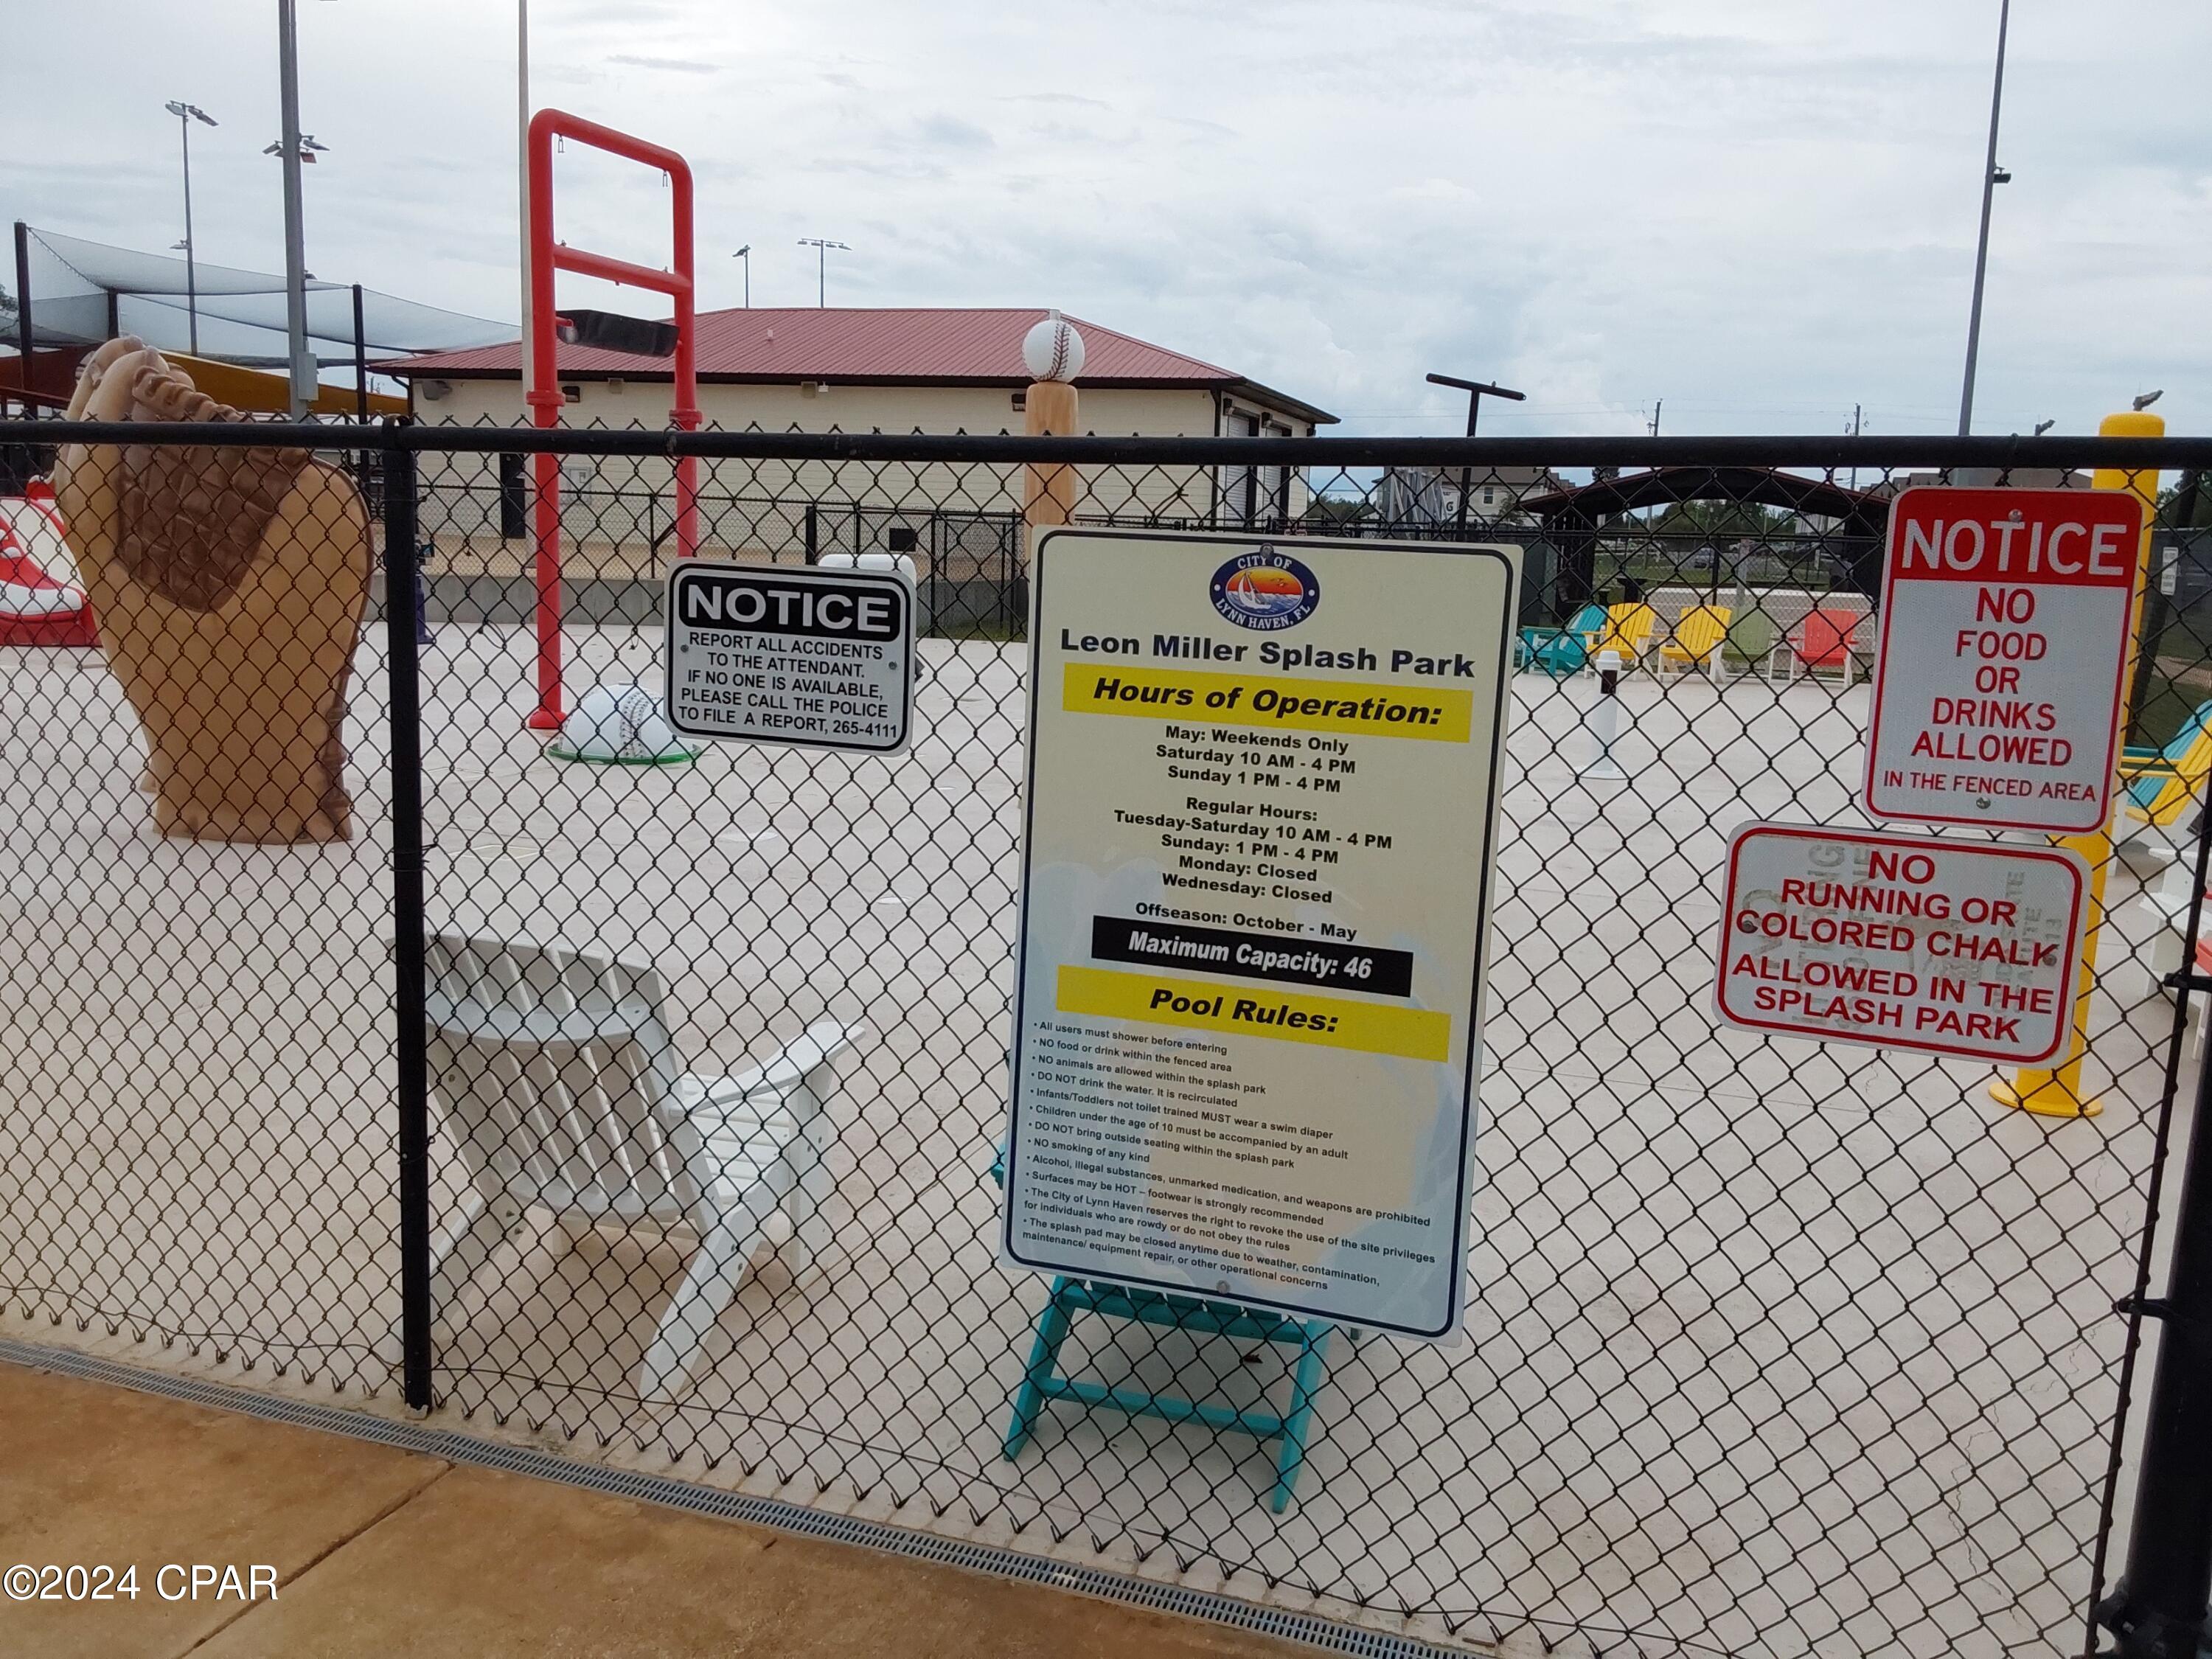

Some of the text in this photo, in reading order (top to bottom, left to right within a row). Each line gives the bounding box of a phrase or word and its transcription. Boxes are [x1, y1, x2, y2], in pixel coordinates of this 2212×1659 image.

[1237, 555, 1293, 569] CITY OF
[1902, 518, 2127, 576] NOTICE
[688, 584, 891, 633] NOTICE
[1216, 598, 1311, 630] LYNN HAVEN, FL
[1976, 587, 2035, 625] NO
[689, 631, 883, 660] REPORT ALL ACCIDENTS
[1060, 627, 1475, 678] Leon Miller Splash Park
[1956, 630, 2047, 661] FOOD
[707, 652, 865, 678] TO THE ATTENDANT.
[1975, 665, 2020, 695] OR
[688, 669, 883, 700] IF NO ONE IS AVAILABLE,
[1092, 676, 1442, 725] Hours of Operation:
[681, 687, 888, 718] PLEASE CALL THE POLICE
[1932, 697, 2056, 731] DRINKS
[678, 706, 897, 738] TO FILE A REPORT, 265-4111
[1165, 724, 1349, 756] May: Weekends Only
[1910, 731, 2072, 767] ALLOWED
[1155, 743, 1234, 767] Saturday
[1239, 751, 1261, 765] 10
[1265, 753, 1295, 768] AM
[1310, 757, 1323, 771] 4
[1327, 758, 1356, 774] PM
[1166, 764, 1232, 786] Sunday
[1237, 771, 1245, 785] 1
[1253, 772, 1280, 787] PM
[1295, 776, 1308, 790] 4
[1312, 776, 1340, 793] PM
[1884, 771, 2096, 802] IN THE FENCED AREA
[1186, 796, 1318, 821] Regular Hours:
[1113, 808, 1270, 840] Tuesday-Saturday
[1275, 824, 1296, 839] 10
[1301, 827, 1330, 843] AM
[1346, 832, 1358, 846] 4
[1363, 833, 1392, 849] PM
[1161, 832, 1229, 855] Sunday:
[1235, 841, 1244, 855] 1
[1251, 842, 1278, 858] PM
[1293, 846, 1306, 860] 4
[1310, 848, 1338, 864] PM
[1178, 854, 1318, 882] Monday: Closed
[1868, 850, 1935, 885] NO
[1161, 872, 1332, 903] Wednesday: Closed
[1781, 878, 2017, 928] RUNNING OR
[1135, 901, 1227, 925] Offseason:
[1232, 912, 1304, 933] October
[1320, 922, 1357, 942] May
[1736, 909, 1915, 952] COLORED
[1927, 931, 2059, 967] CHALK
[1127, 930, 1373, 978] Maximum Capacity: 46
[1732, 953, 2053, 1015] ALLOWED IN THE
[1149, 987, 1339, 1033] Pool Rules:
[1754, 986, 2021, 1043] SPLASH PARK
[1038, 1020, 1228, 1056] All users must shower before entering
[1038, 1037, 1232, 1072] NO food or drink within the fenced area
[1037, 1070, 1238, 1107] DO NOT drink the water. It is recirculated
[1033, 1136, 1150, 1163] NO smoking of any kind
[1031, 1169, 1074, 1186] Surfaces
[1076, 1178, 1098, 1191] may
[1099, 1180, 1113, 1191] be
[1114, 1182, 1137, 1194] HOT
[1147, 1187, 1192, 1203] footwear
[1193, 1194, 1203, 1205] is
[1205, 1198, 1248, 1214] strongly
[1249, 1206, 1324, 1225] recommended
[1032, 1153, 1430, 1227] Alcohol, illegal substances, unmarked medication, and weapons are prohibited
[1022, 1231, 1328, 1290] maintenance/ equipment repair, or other operational concerns
